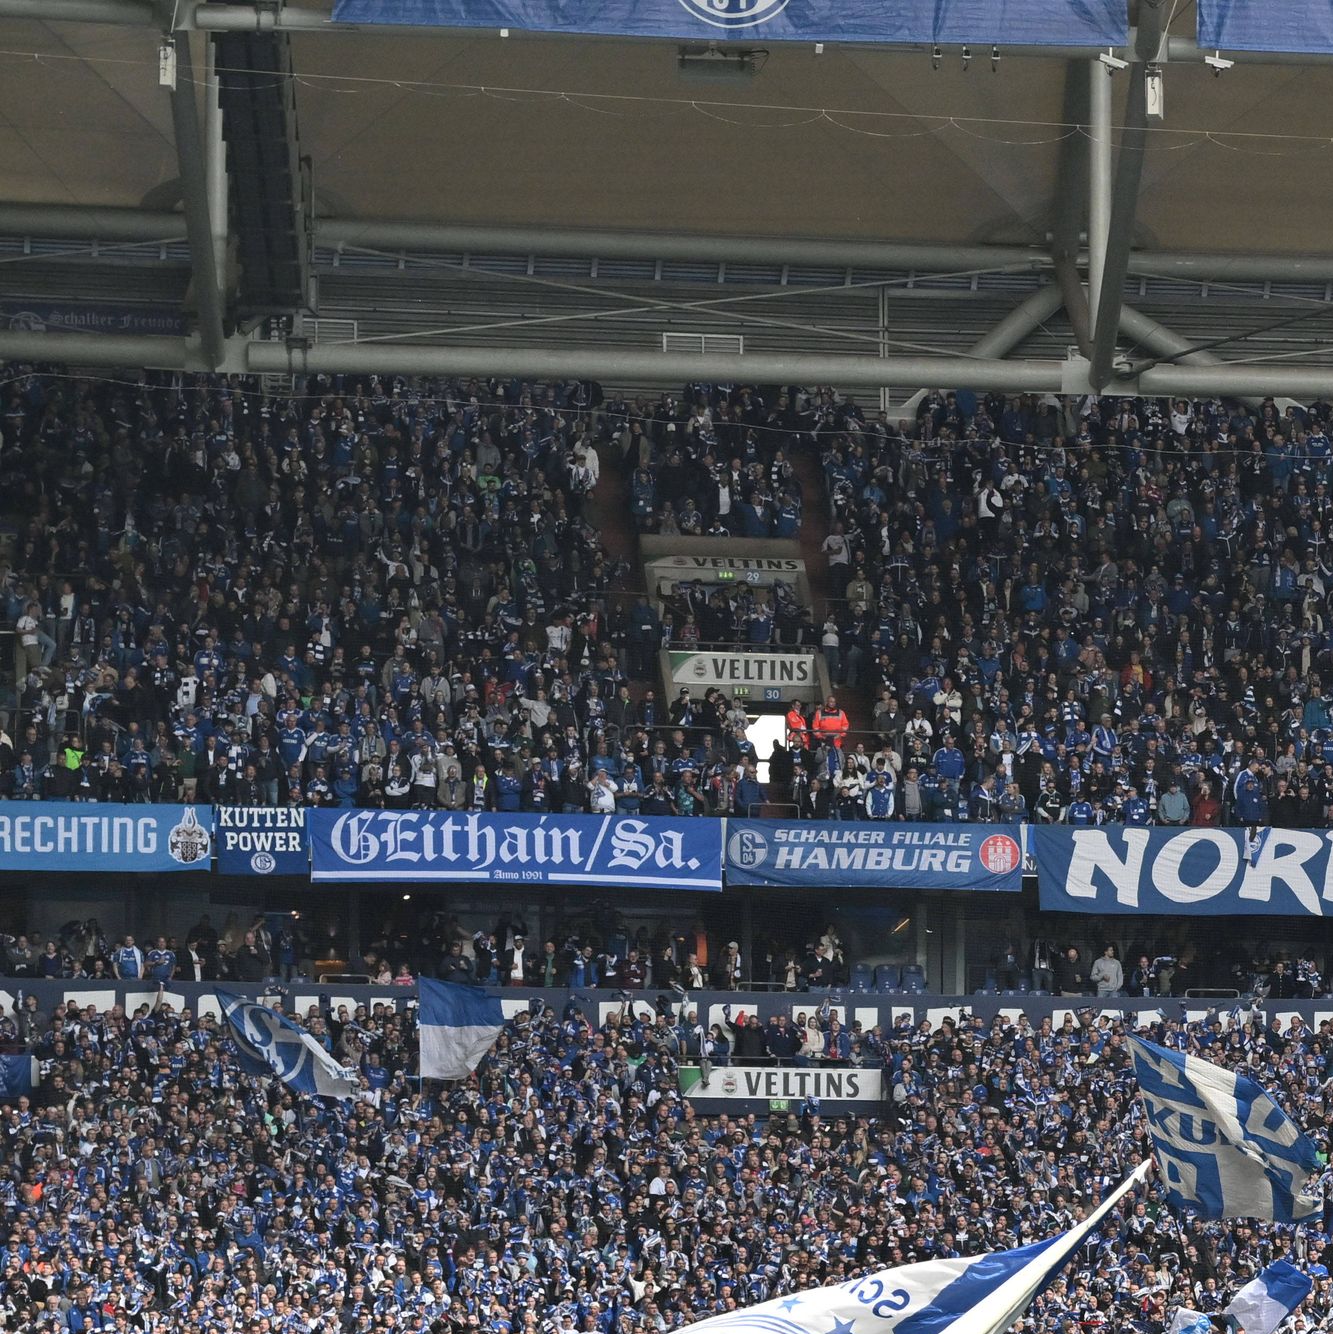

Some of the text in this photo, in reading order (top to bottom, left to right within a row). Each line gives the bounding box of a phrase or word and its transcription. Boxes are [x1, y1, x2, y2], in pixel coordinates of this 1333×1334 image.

[692, 556, 799, 571] VELTINS
[746, 571, 760, 583] 29
[712, 658, 809, 681] VELTINS
[765, 689, 780, 701] 30
[219, 806, 305, 828] KUTTEN
[225, 831, 302, 852] POWER
[774, 828, 972, 847] SCHALKER FILIALE
[774, 847, 972, 874] HAMBURG
[493, 870, 543, 881] Anno 1991
[744, 1071, 860, 1098] VELTINS
